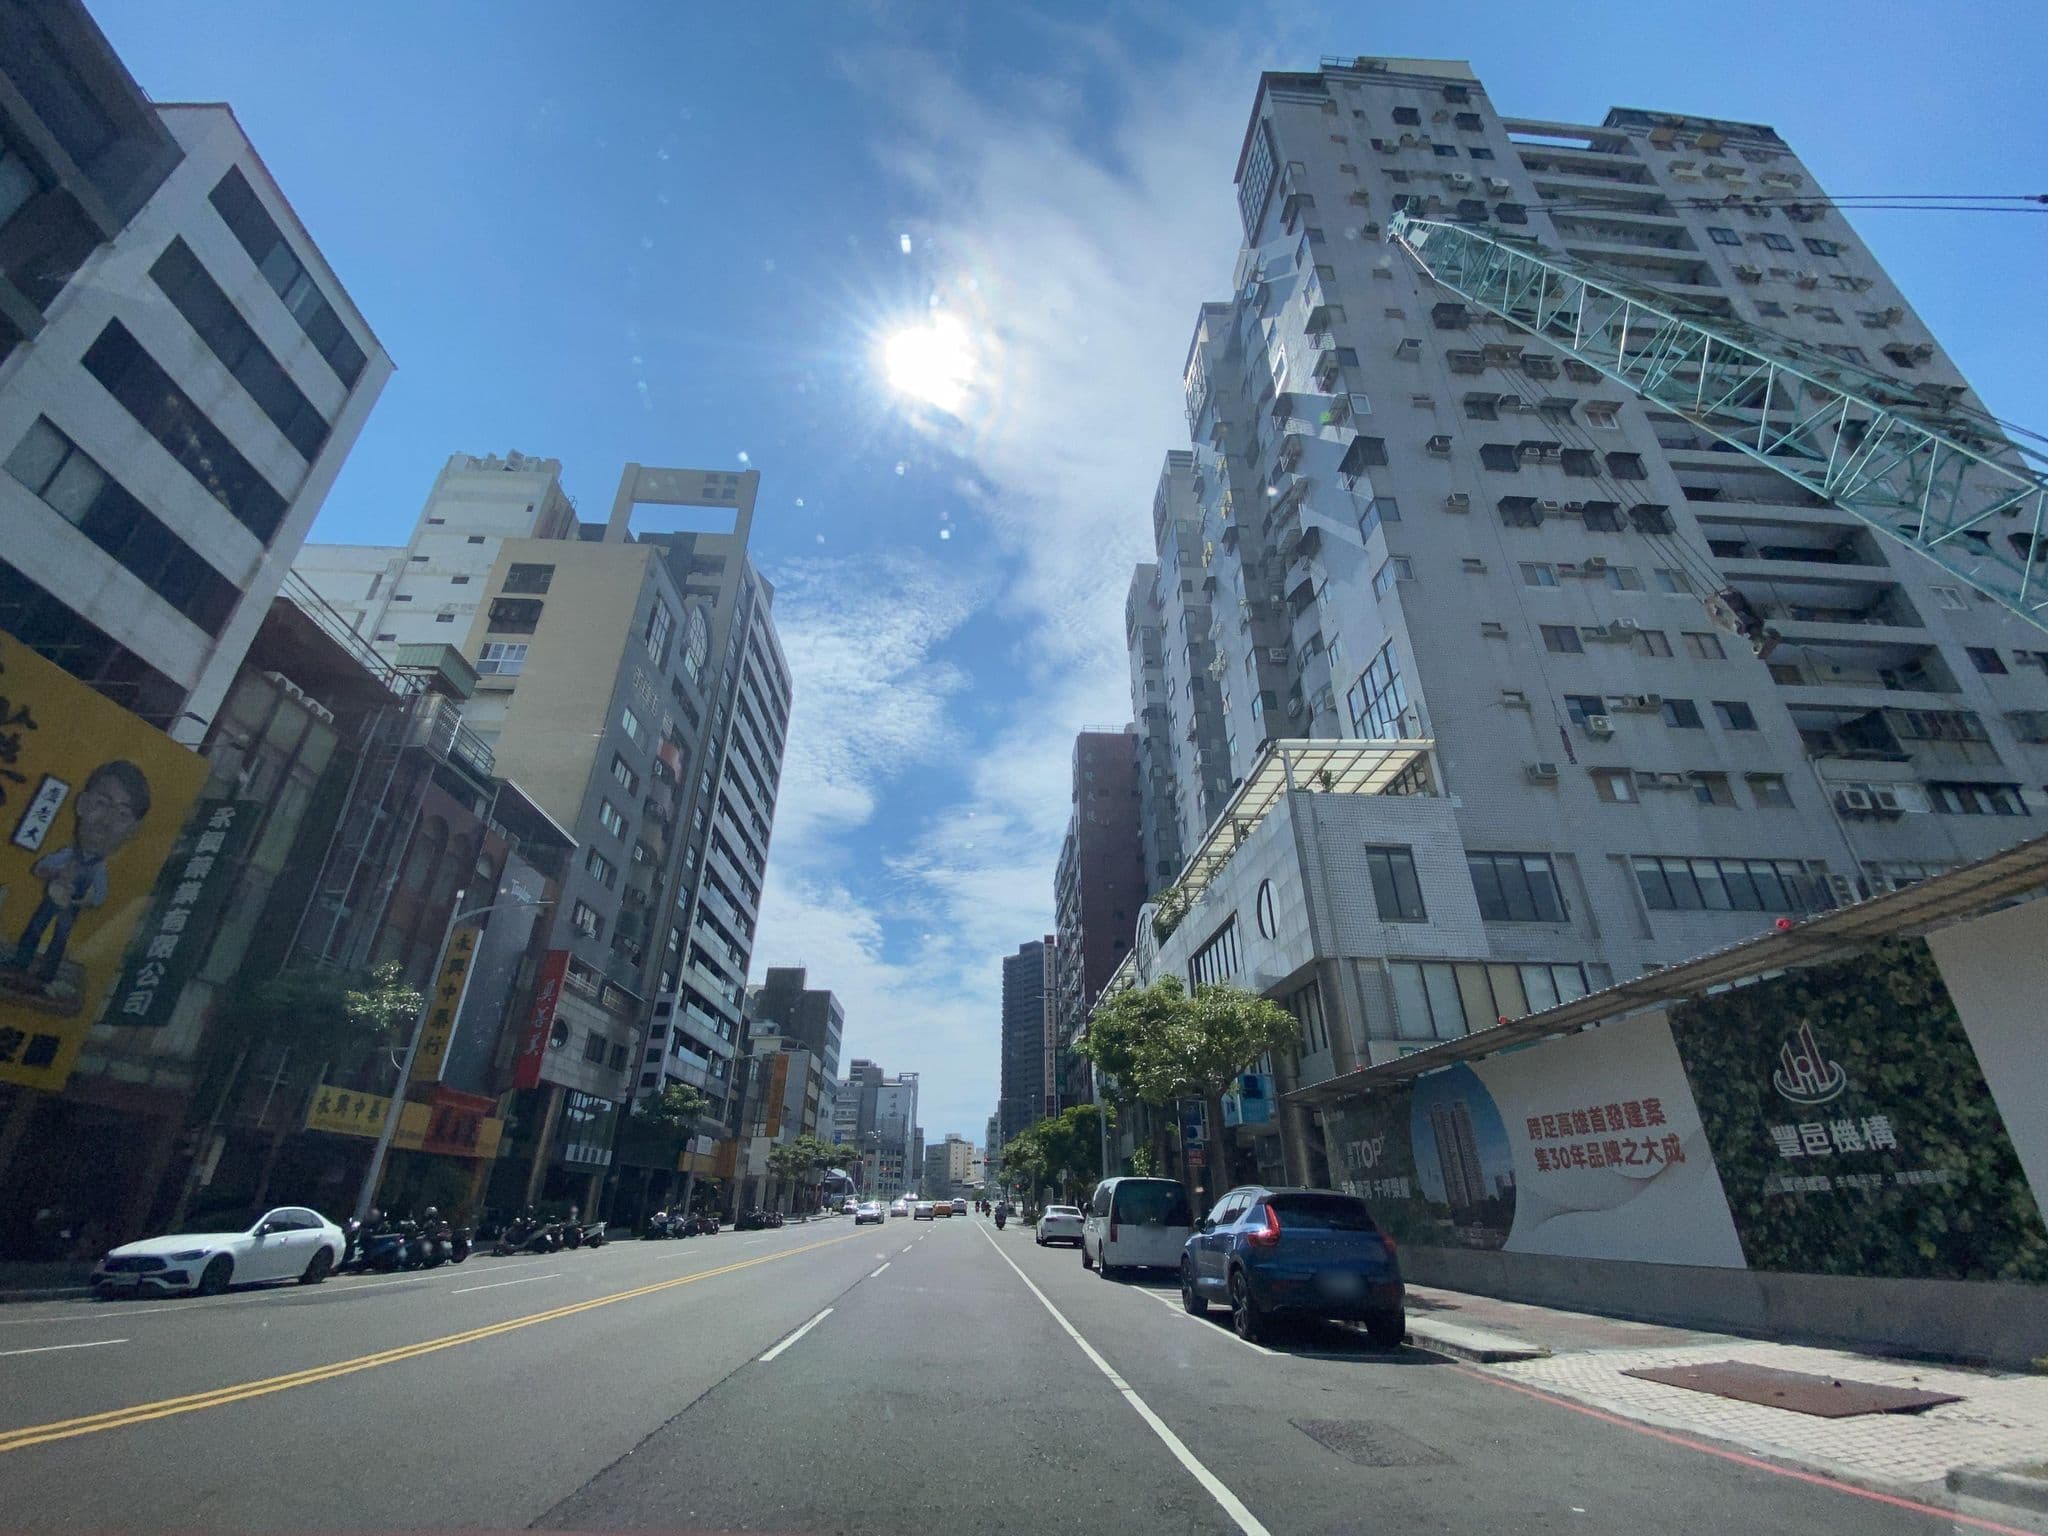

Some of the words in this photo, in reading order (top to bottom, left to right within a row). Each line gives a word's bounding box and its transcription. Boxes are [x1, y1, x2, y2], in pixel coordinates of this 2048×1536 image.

[1526, 1098, 1667, 1140] 跨足高雄首發建案
[1769, 1115, 1897, 1157] 豐邑機構
[1534, 1132, 1686, 1173] 集30年品牌之大成
